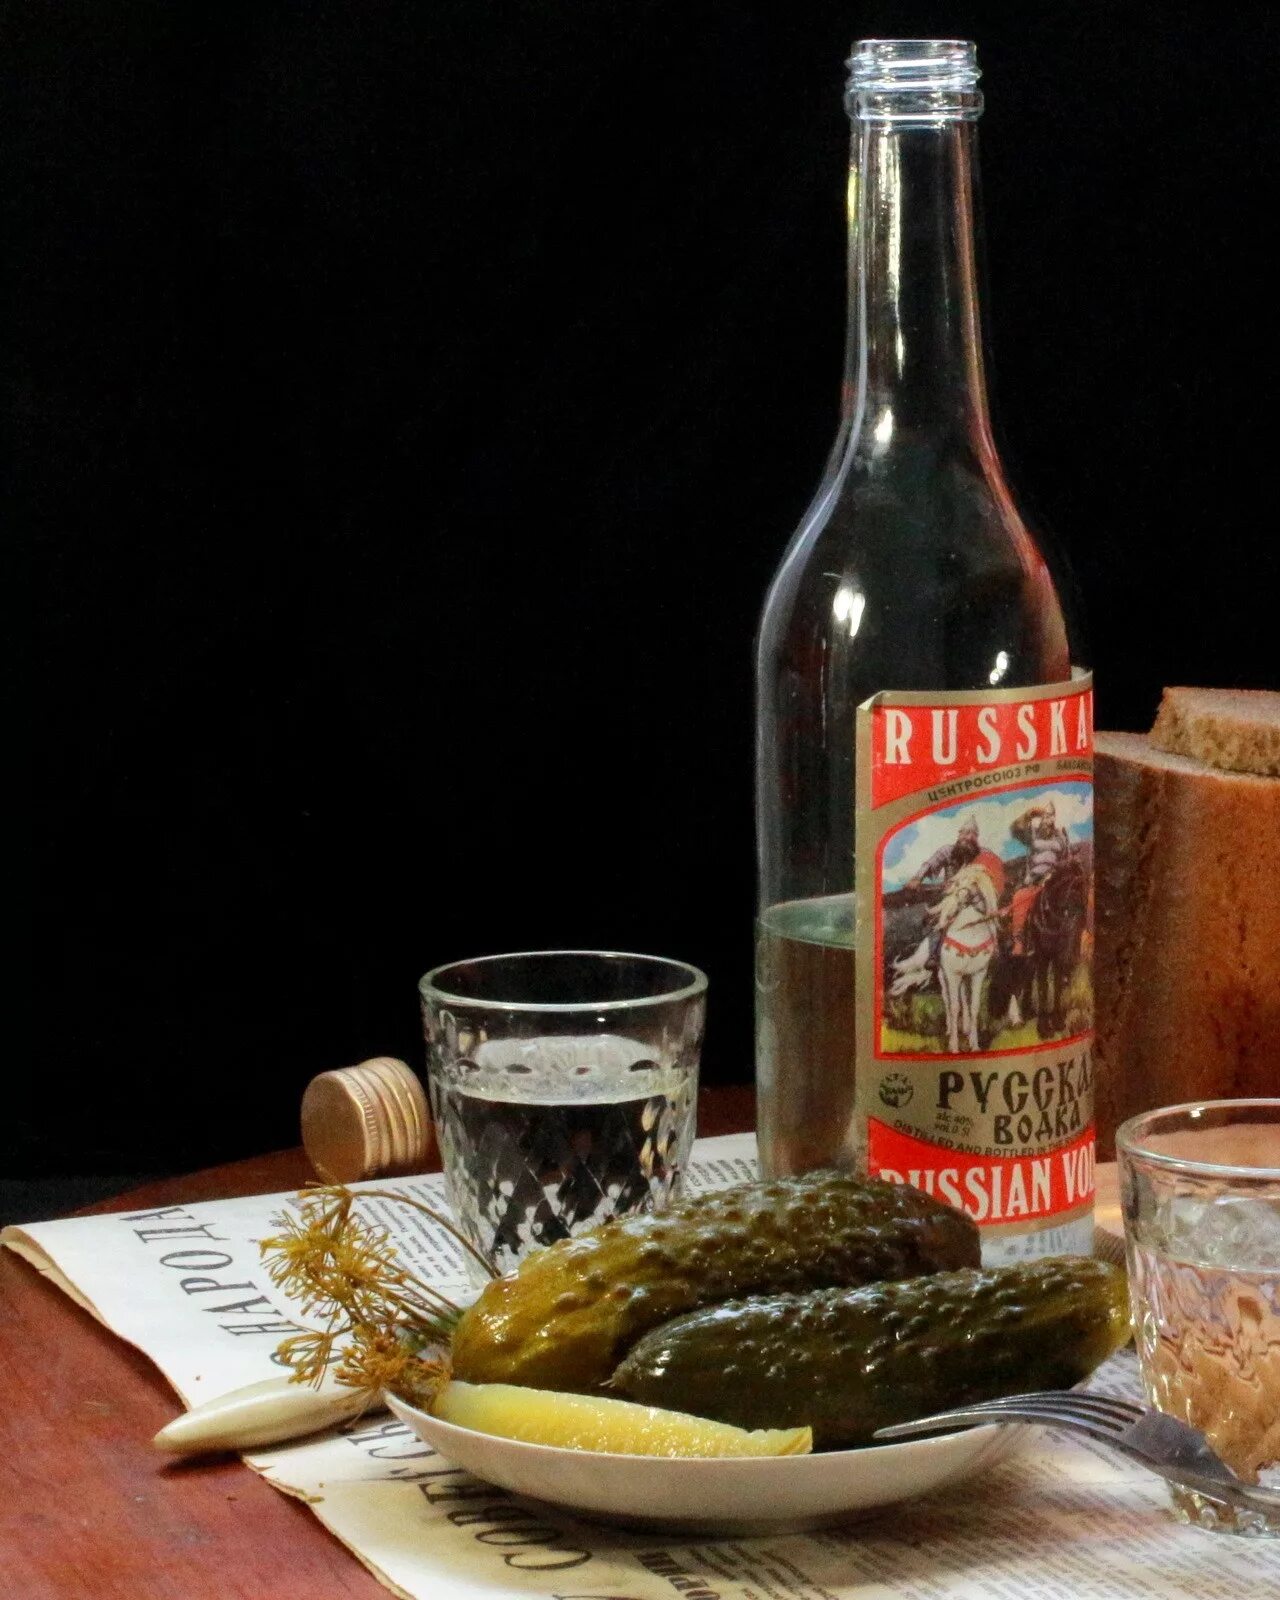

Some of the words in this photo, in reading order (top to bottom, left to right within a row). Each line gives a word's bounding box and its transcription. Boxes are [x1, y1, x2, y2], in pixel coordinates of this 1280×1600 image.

[884, 691, 1093, 765] RUSSKA
[927, 768, 1022, 802] ЦЕНТРОСОЮЗ
[936, 1051, 1093, 1114] РУССКА
[894, 1119, 954, 1149] DISTILLED
[956, 1143, 982, 1156] AND
[985, 1146, 1035, 1157] BOTTLED
[993, 1101, 1081, 1145] ВОДКА
[120, 1206, 310, 1337] НАРОДА
